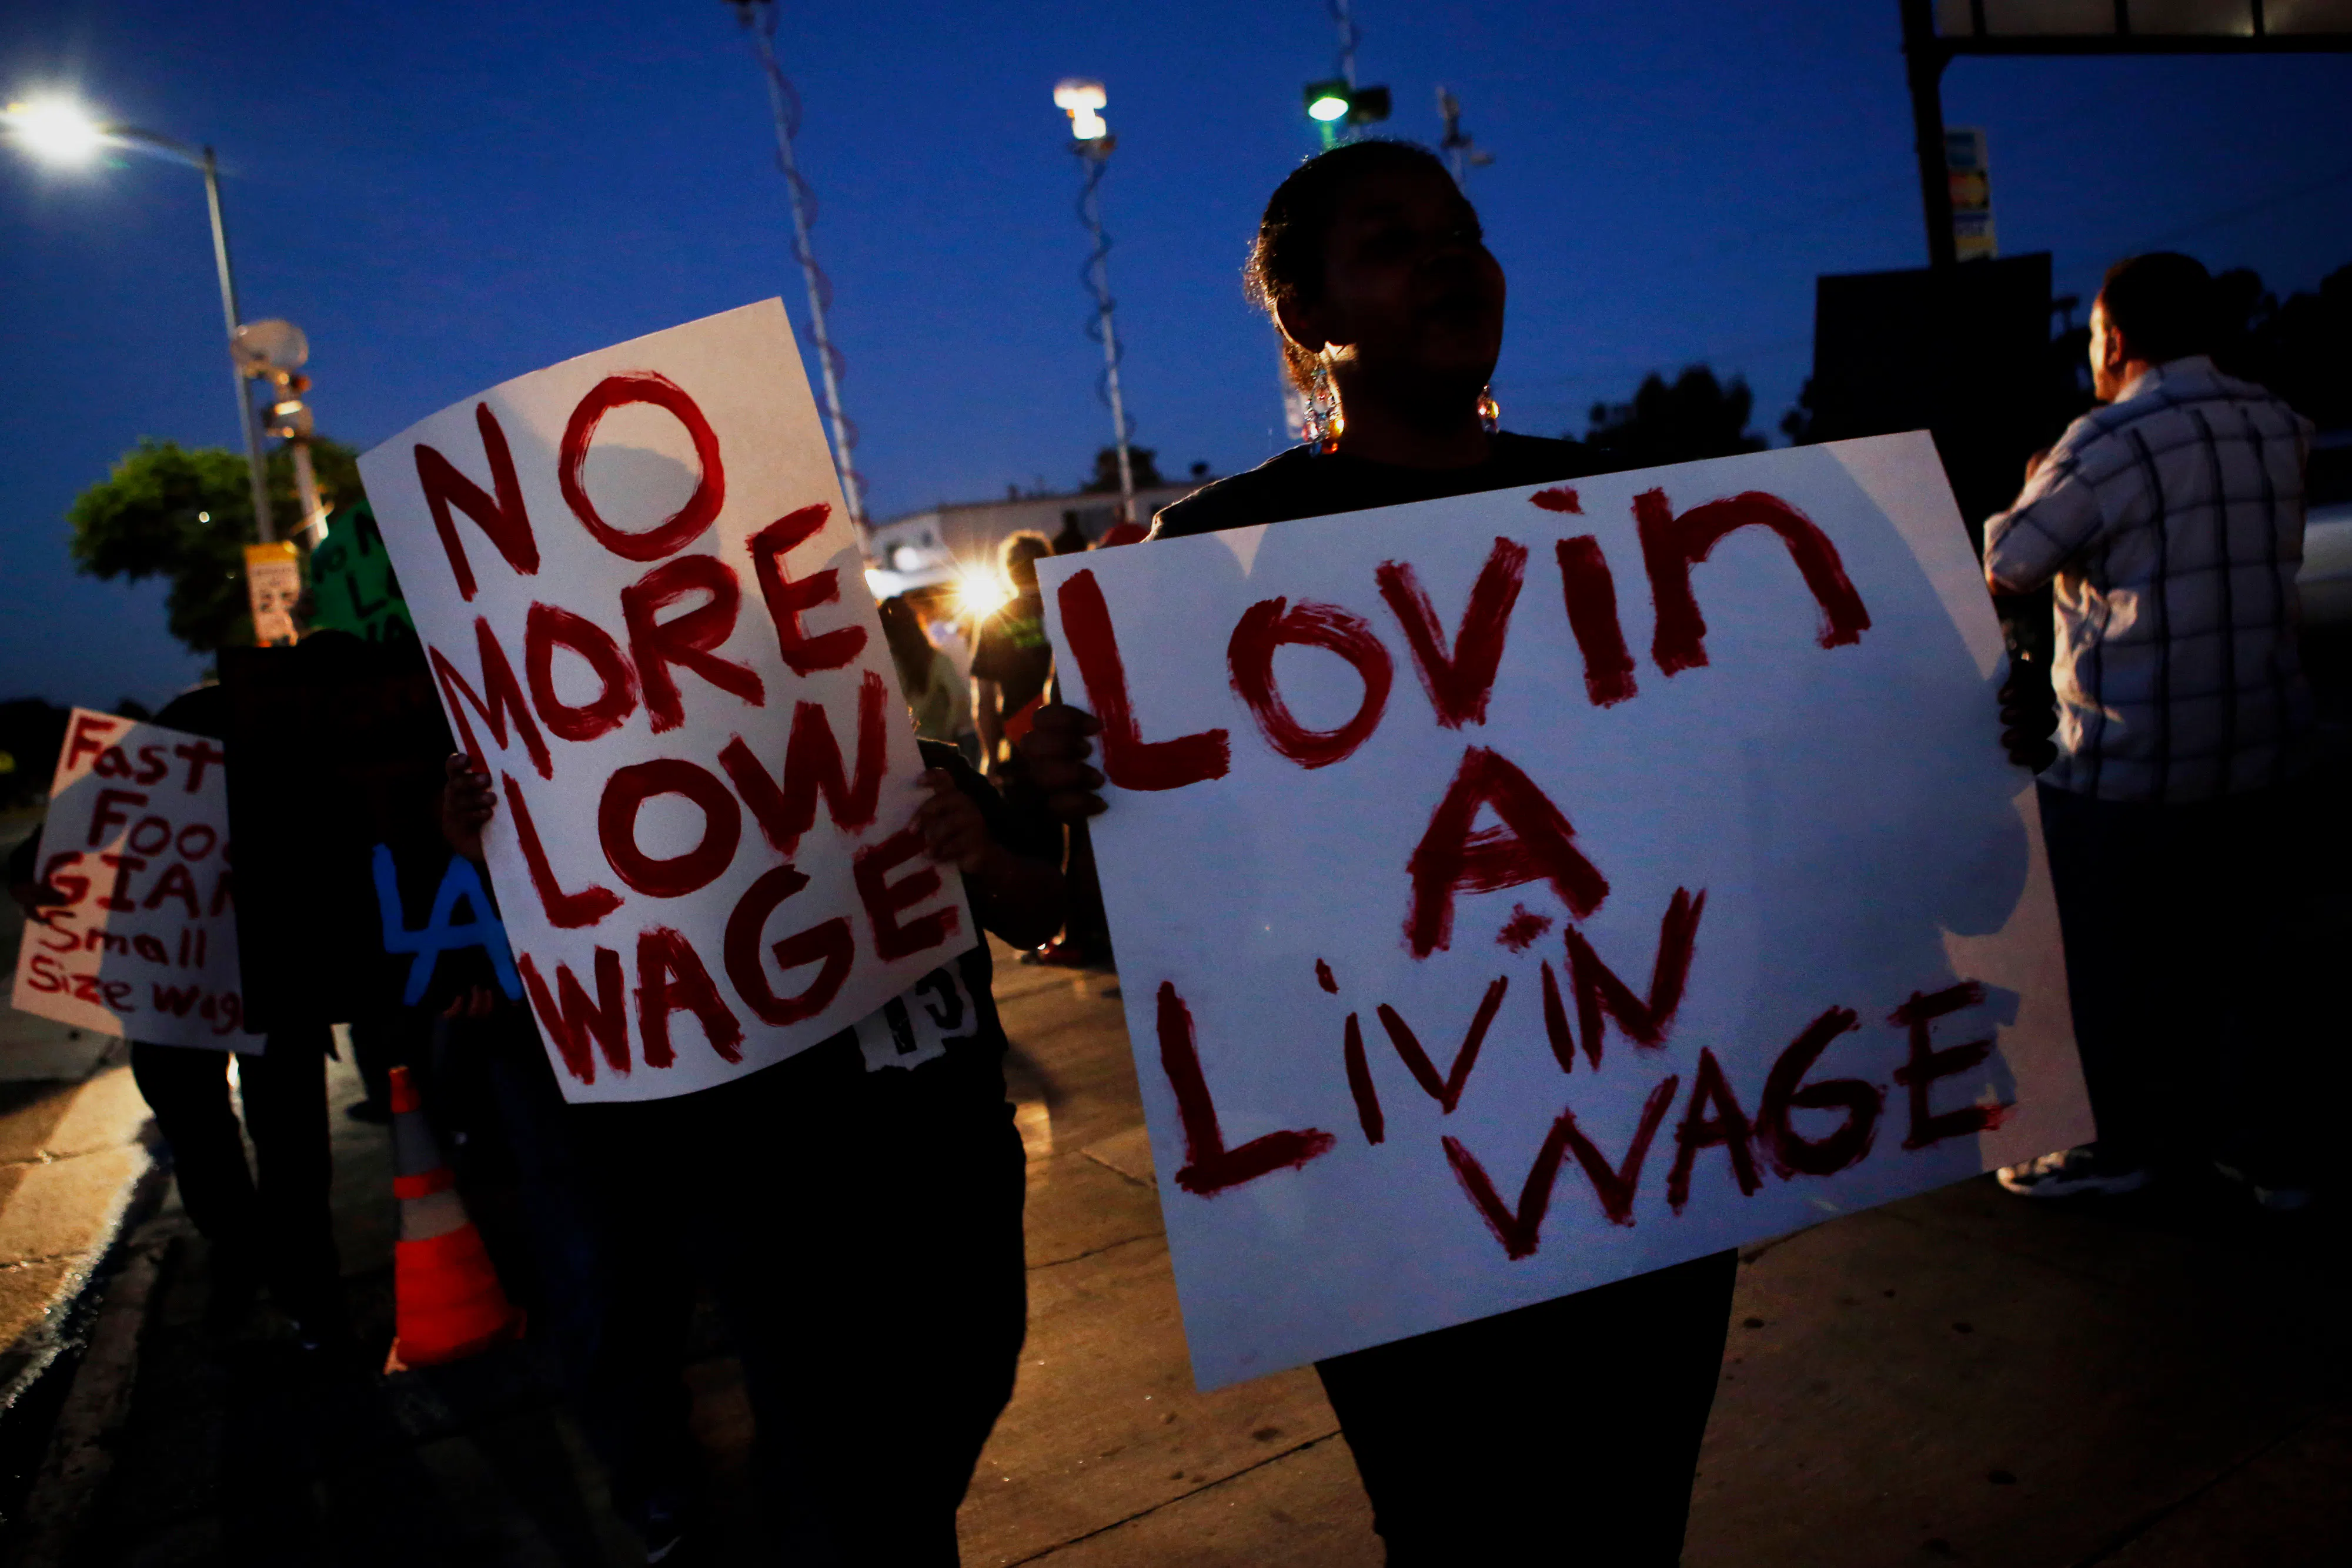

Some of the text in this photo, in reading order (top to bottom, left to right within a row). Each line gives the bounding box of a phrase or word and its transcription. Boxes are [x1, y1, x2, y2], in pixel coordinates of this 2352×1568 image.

[413, 371, 724, 601] NO
[428, 503, 867, 781] MORE
[88, 789, 235, 862] Foo
[503, 670, 887, 927] LOW
[1404, 745, 1610, 959] A
[517, 825, 964, 1086] WAGE
[1442, 981, 2017, 1260] WAGE
